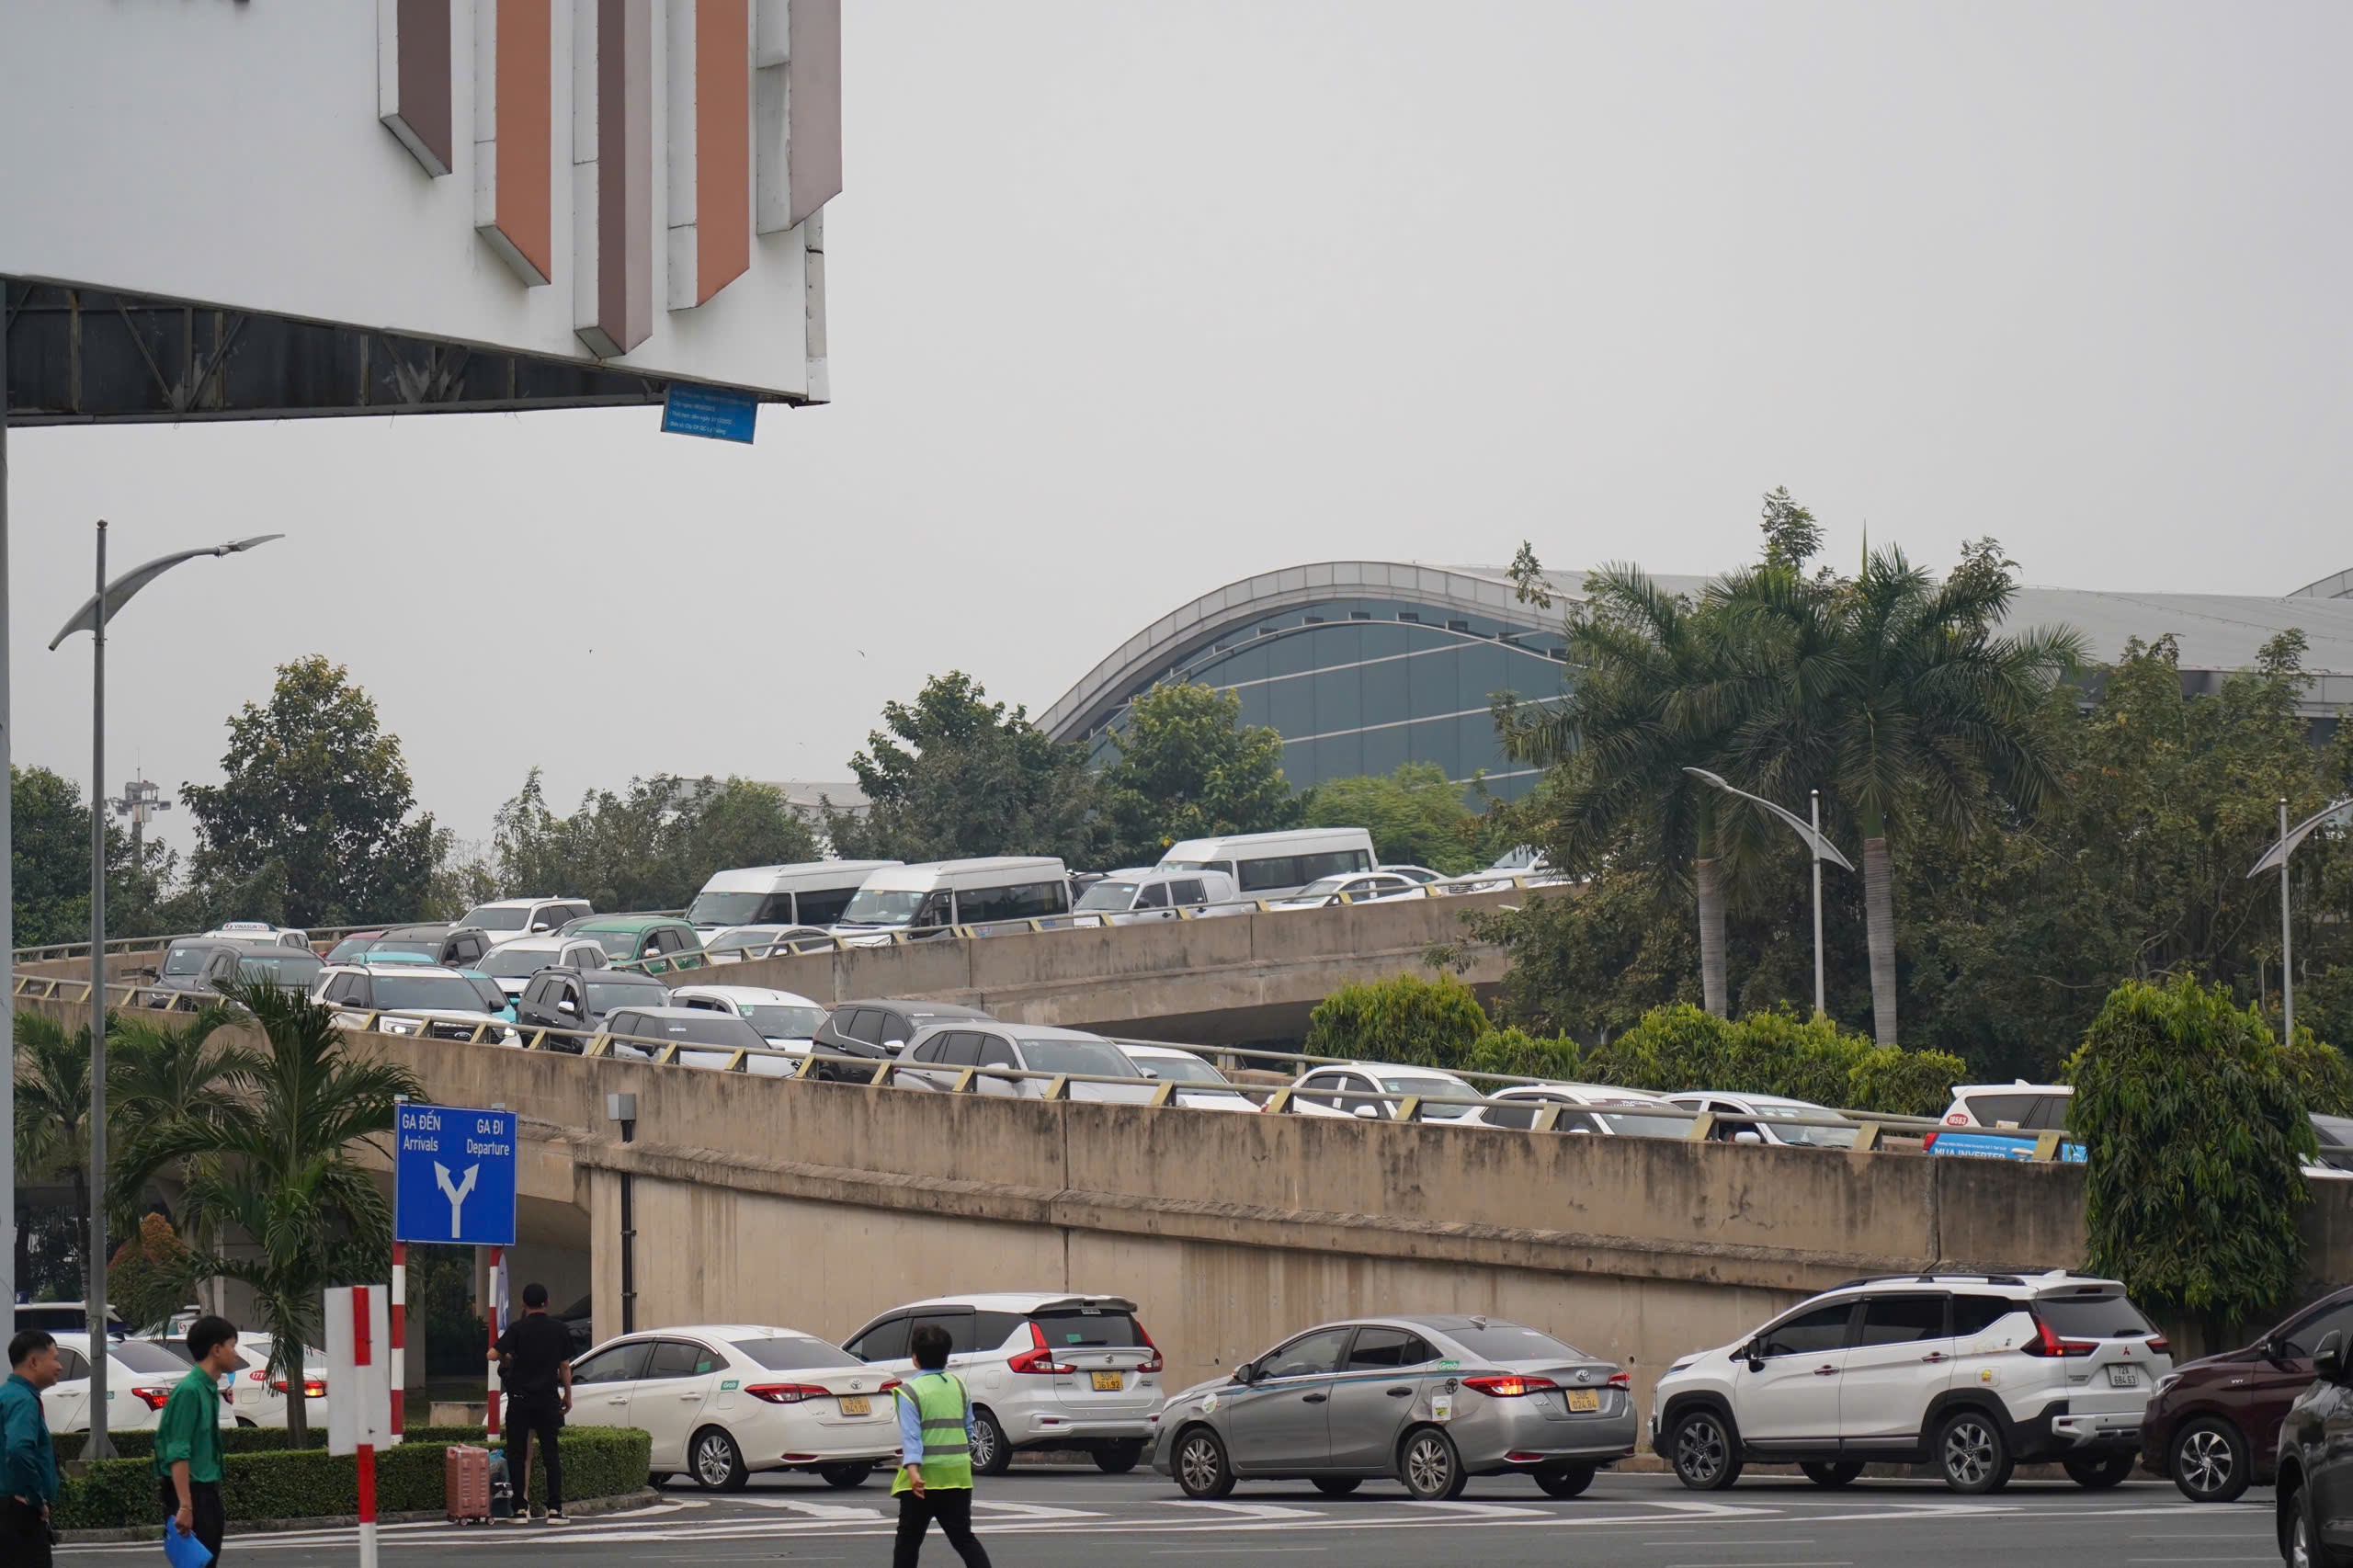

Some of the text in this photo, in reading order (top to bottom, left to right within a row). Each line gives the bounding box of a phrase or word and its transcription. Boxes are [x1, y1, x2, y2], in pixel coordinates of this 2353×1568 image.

[402, 1109, 441, 1131] GA ĐẾN
[477, 1119, 504, 1135] GA ĐI
[404, 1135, 438, 1152] Arrivals
[466, 1139, 510, 1158] Departure
[1438, 1361, 1458, 1369] Grab
[2117, 1365, 2129, 1374] 72A
[1097, 1381, 1120, 1389] 361.92
[1574, 1390, 1589, 1400] 50E
[1572, 1399, 1597, 1409] 024.84
